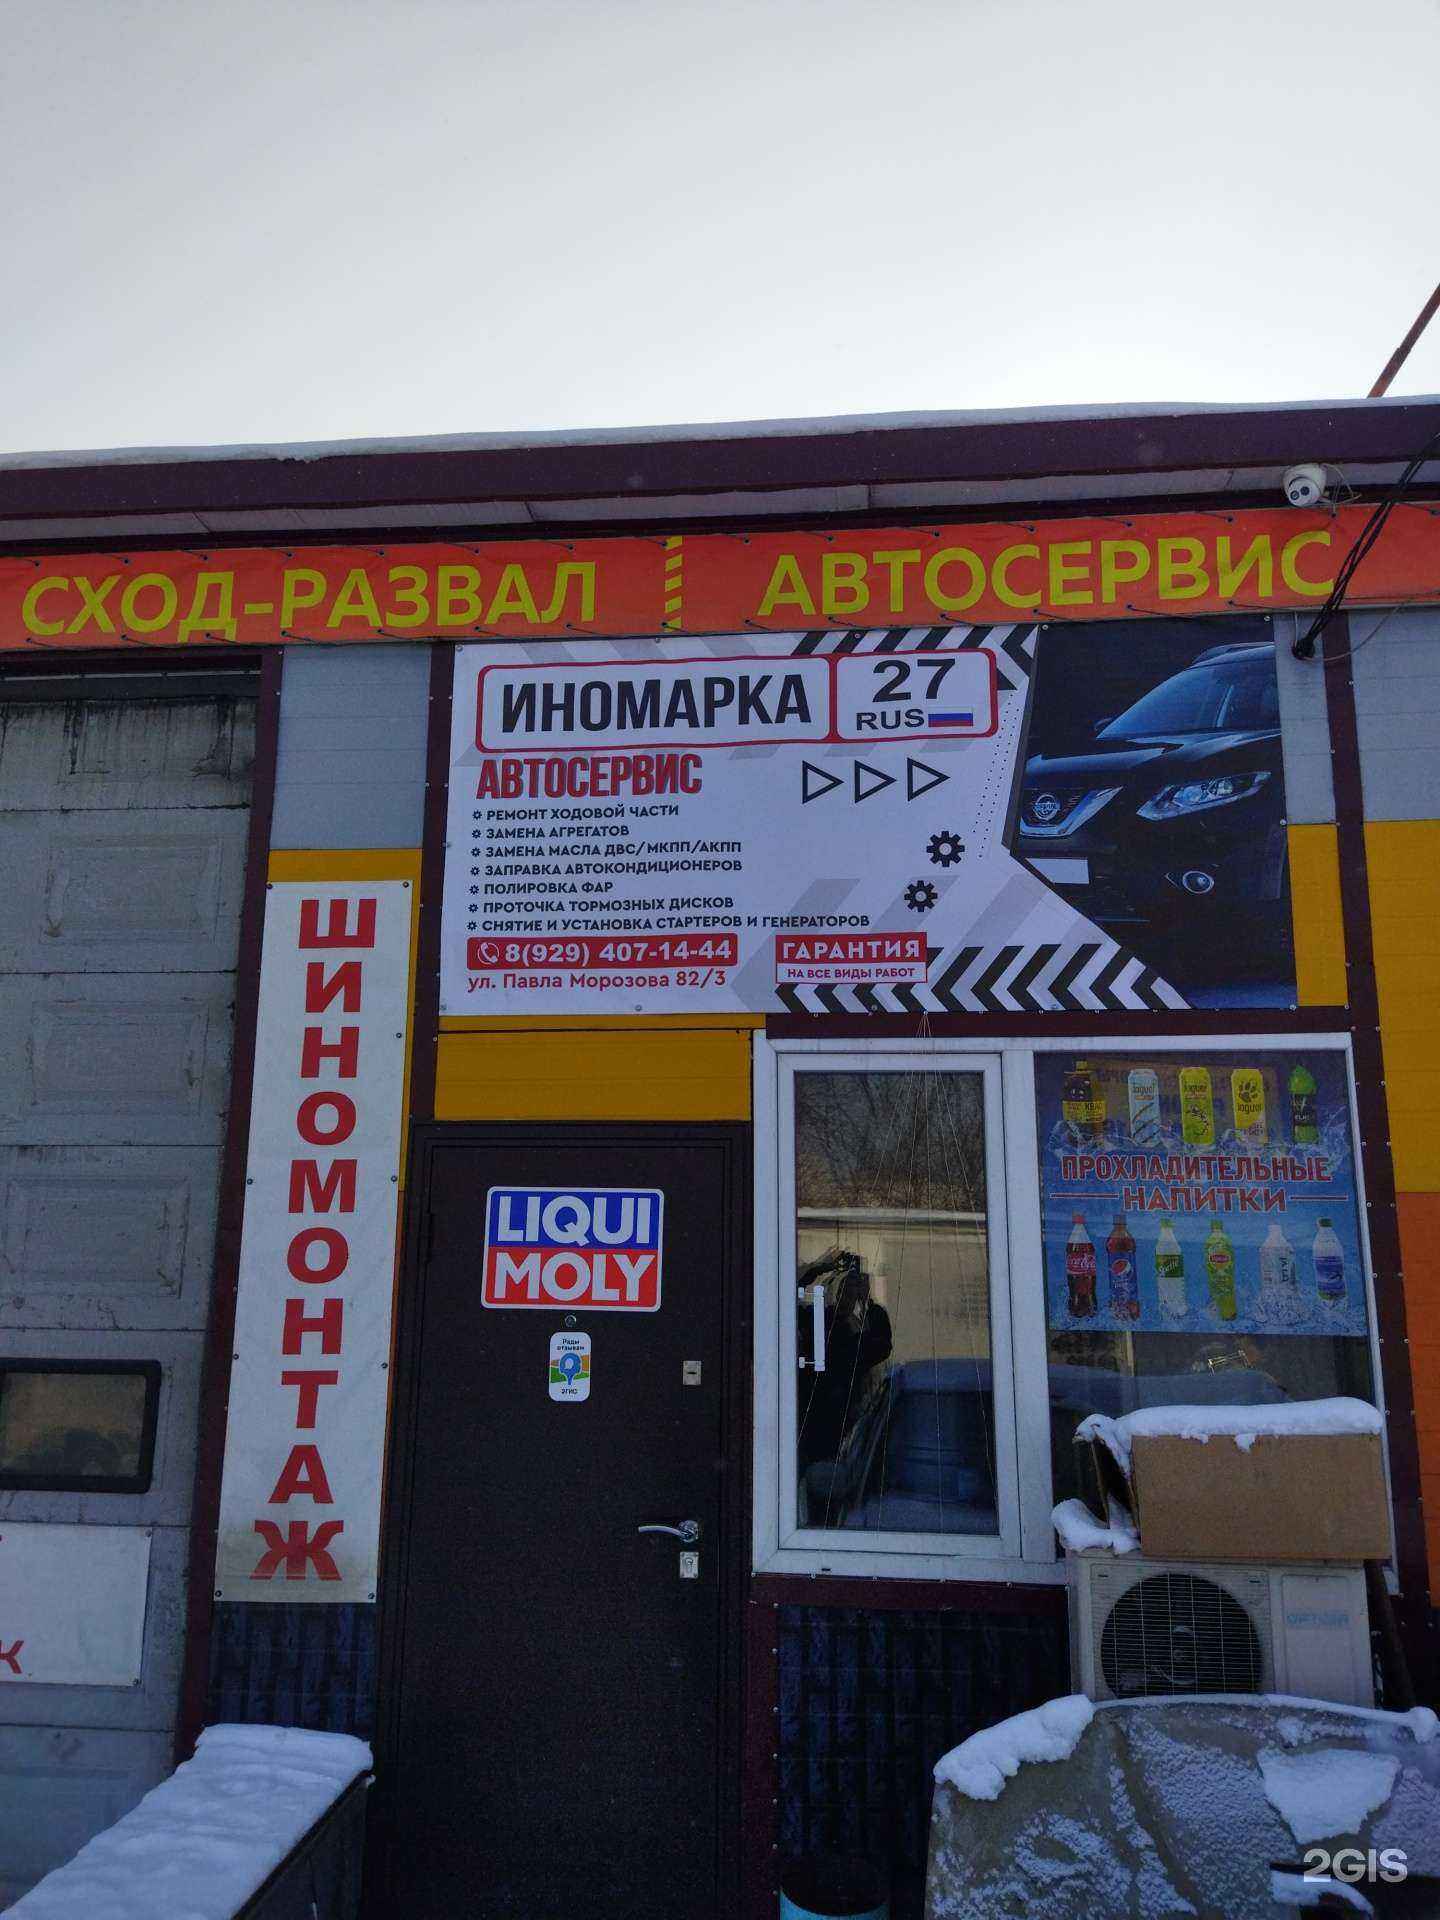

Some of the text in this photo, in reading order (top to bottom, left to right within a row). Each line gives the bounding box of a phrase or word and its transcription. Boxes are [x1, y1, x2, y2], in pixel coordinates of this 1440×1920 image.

[757, 531, 1335, 616] АВТОСЕРВИС
[22, 561, 597, 642] СХОД-РАЗВАЛ
[872, 658, 956, 703] 27
[502, 674, 812, 733] ИНОМАРКА
[856, 708, 925, 731] RUS
[476, 754, 703, 799] АВТОСЕРВИС
[486, 804, 679, 821] РЕМОНТ ХОДОВОЙ ЧАСТИ
[486, 825, 630, 839] ЗАМЕНА АГРЕГАТОВ
[485, 845, 545, 857] ЗАМЕНА
[549, 844, 601, 857] МАСЛА
[485, 859, 742, 876] ЗАПРАВКА АВТОКОНДИЦИОНЕРОВ
[484, 882, 613, 895] ПОЛИРОВКА ФАР
[483, 897, 734, 913] ПРОТОЧКА ТОРМОЗНЫХ ДИСКОВ
[482, 915, 870, 931] СНЯТИЕ И УСТАНОВКА СТАРТЕРОВ И ГЕНЕРАТОРОВ
[505, 939, 732, 966] 8(929) 407-14-44
[783, 940, 920, 960] ГАРАНТИЯ
[467, 969, 726, 992] ул. Павла Морозова 82/3
[788, 967, 915, 979] НА ВСЕ ВИДЫ РАБОТ
[1062, 1154, 1334, 1184] ПРОХЛАДИТЕЛЬНЫЕ
[1122, 1185, 1288, 1213] НАПИТКИ
[498, 1195, 651, 1247] LIQUI
[249, 898, 378, 1582] ШИНОМОНТАЖ
[494, 1251, 656, 1302] MOLY
